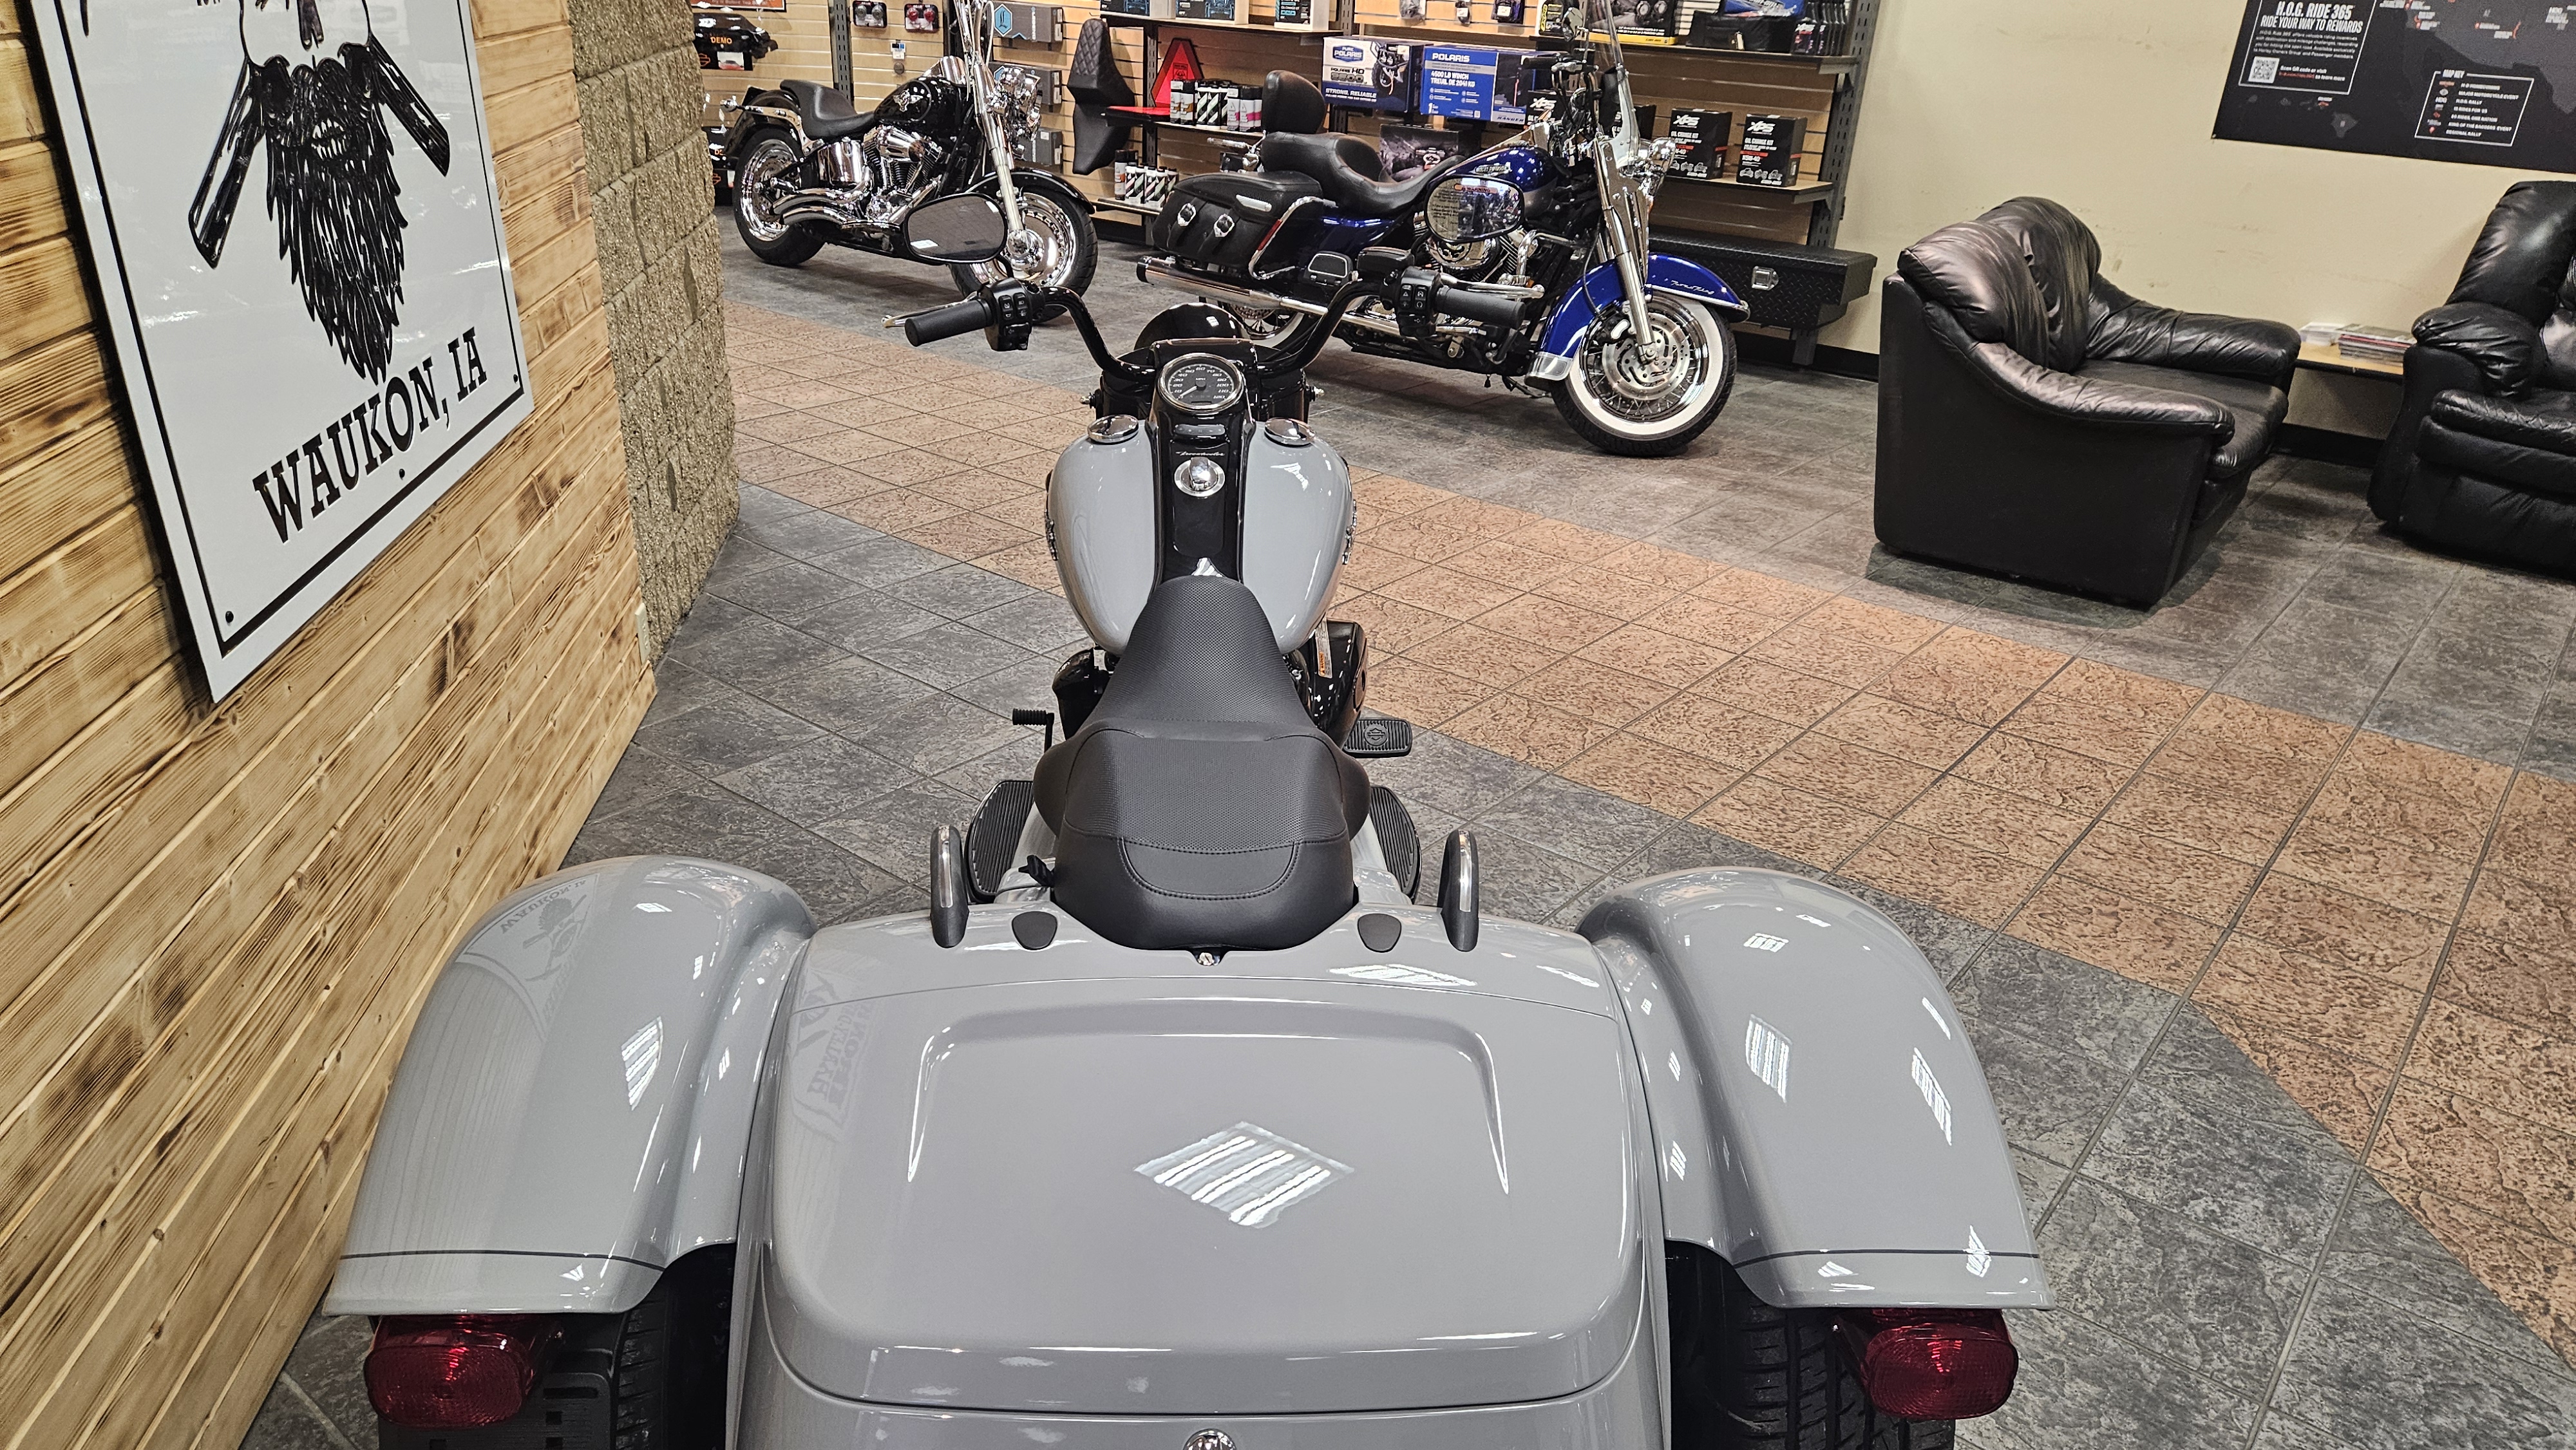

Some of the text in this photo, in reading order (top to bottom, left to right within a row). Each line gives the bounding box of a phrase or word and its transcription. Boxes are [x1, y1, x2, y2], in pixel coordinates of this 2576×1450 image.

[2276, 1, 2353, 20] H.O.G. RIDE 365
[2260, 15, 2363, 33] RIDE YOUR WAY TO REWARDS
[1432, 53, 1470, 62] POLARIS
[1325, 88, 1377, 99] STRONG, RELIABLE
[1530, 97, 1557, 109] XPS
[1673, 115, 1700, 126] XPS
[1747, 121, 1776, 132] XPS
[252, 326, 488, 543] WAUKON, IA
